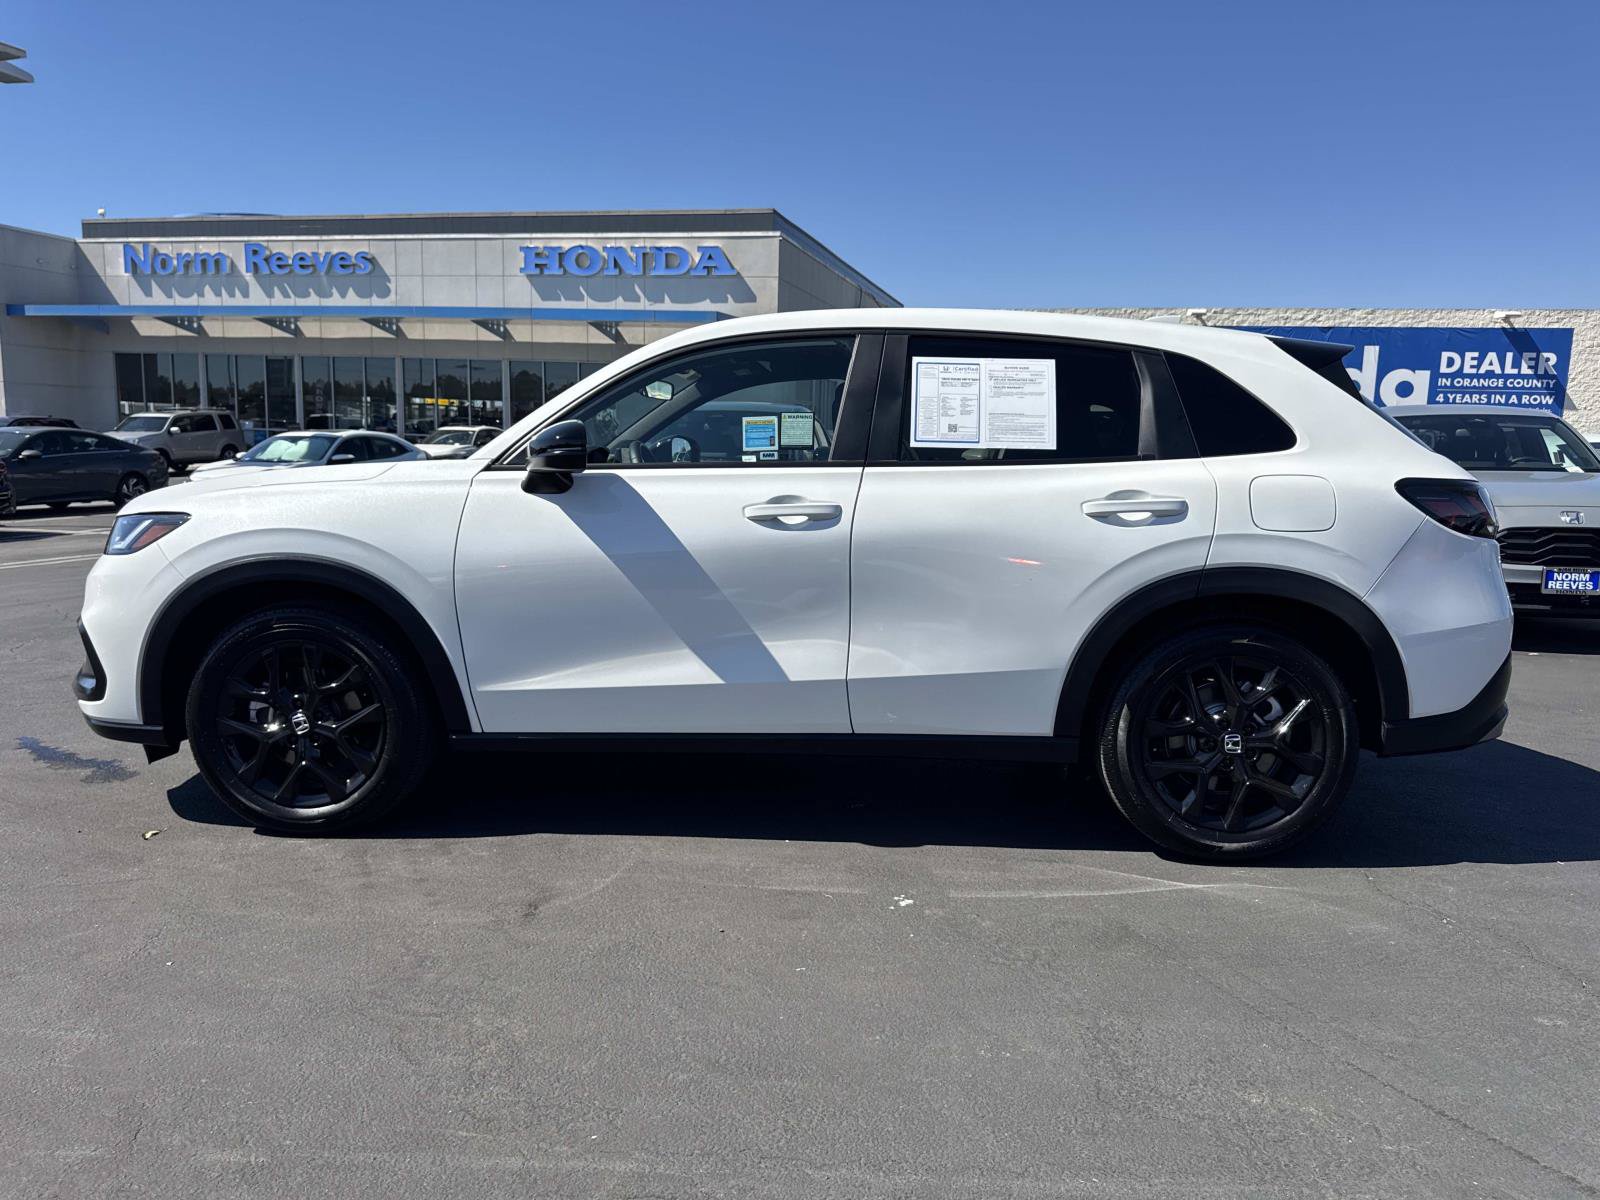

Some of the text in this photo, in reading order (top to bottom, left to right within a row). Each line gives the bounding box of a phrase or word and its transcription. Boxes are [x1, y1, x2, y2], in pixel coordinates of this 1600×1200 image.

[123, 242, 375, 276] Norm Reeves
[519, 244, 738, 277] HONDA
[1439, 351, 1558, 375] DEALER
[1437, 377, 1556, 388] IN ORANGE COUNTY
[1435, 393, 1556, 405] 4 YEARS IN A ROW
[1553, 573, 1590, 581] NORM
[1548, 581, 1593, 590] REEVES
